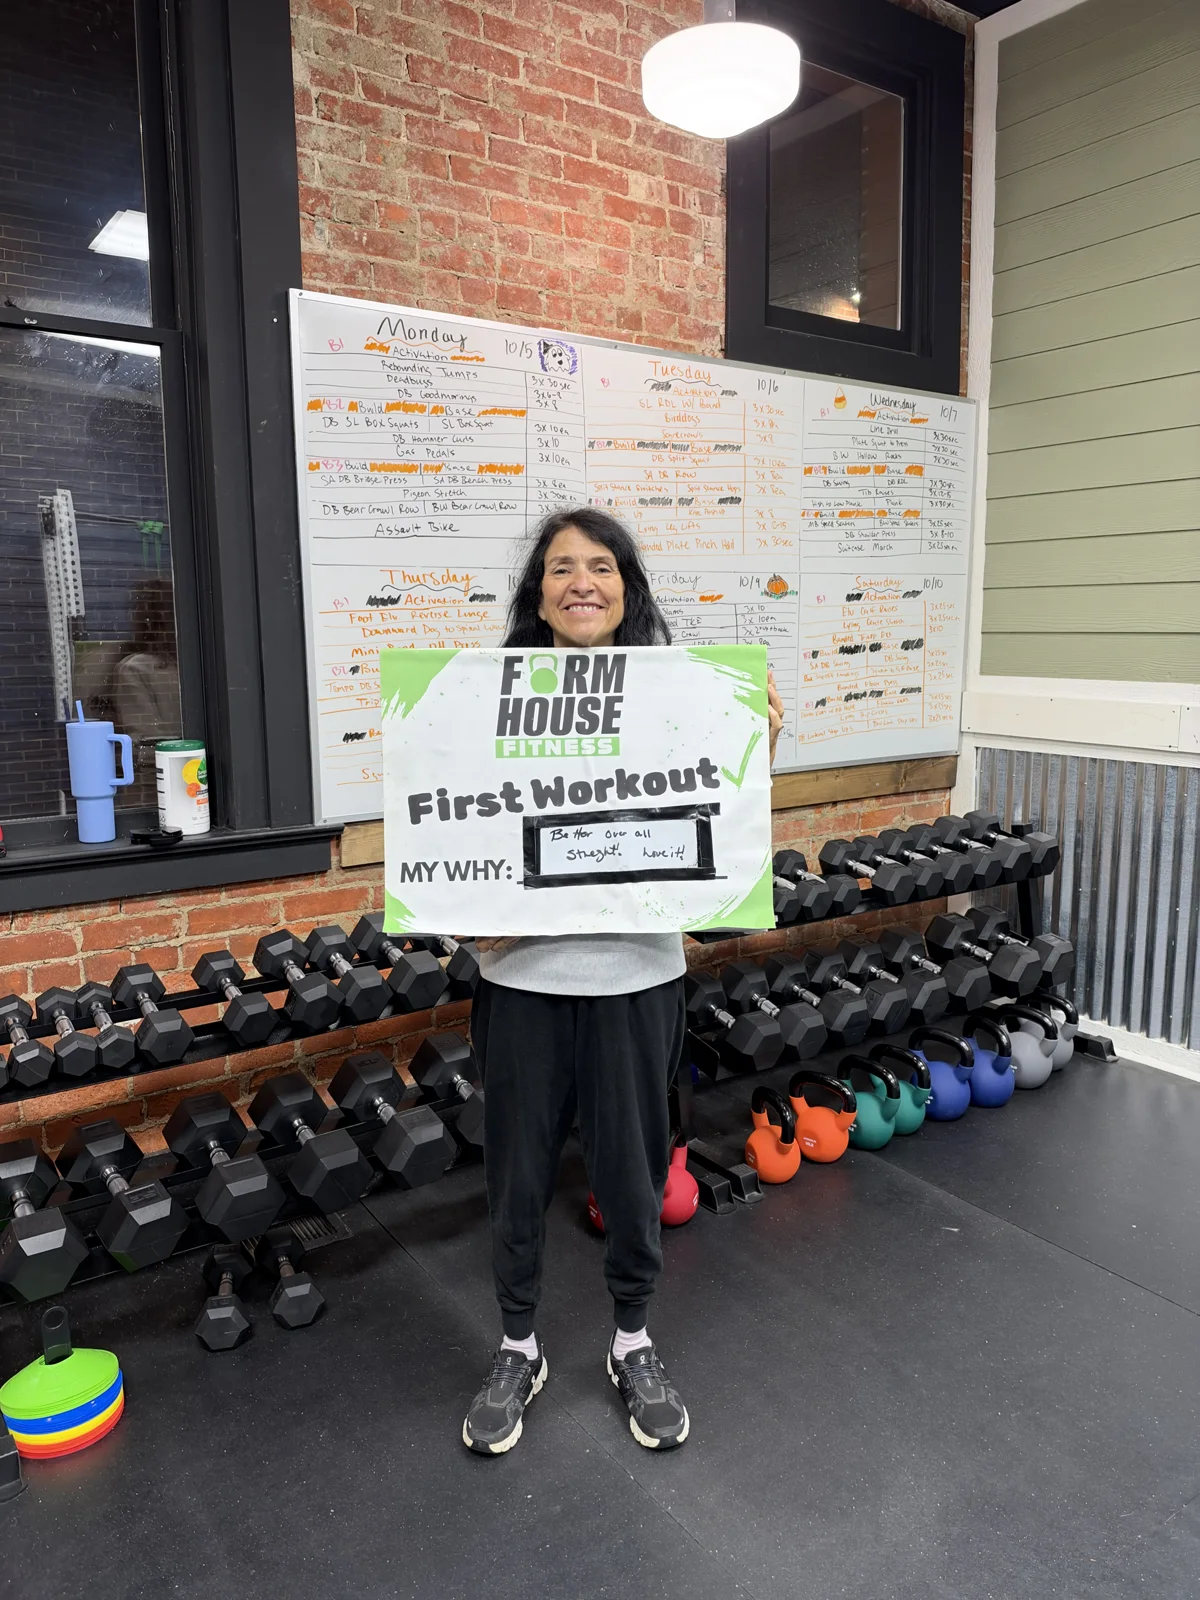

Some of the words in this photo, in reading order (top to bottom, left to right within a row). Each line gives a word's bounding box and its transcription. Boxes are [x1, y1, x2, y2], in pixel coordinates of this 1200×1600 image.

[377, 316, 468, 352] Monday
[328, 338, 344, 352] B1
[504, 338, 533, 359] 10/5
[393, 346, 448, 361] Activation
[381, 360, 432, 376] Rebounding
[436, 367, 478, 380] Jumps
[648, 360, 711, 383] Tuesday
[386, 374, 433, 388] Deadbugs
[600, 377, 610, 388] B1
[757, 378, 779, 395] 10/6
[397, 389, 412, 398] DB
[673, 386, 717, 396] Activation
[326, 398, 344, 410] B2
[358, 400, 385, 414] Build
[639, 399, 652, 409] SL
[657, 397, 676, 409] RDL
[699, 398, 721, 409] Band
[870, 392, 917, 416] Wednesday
[445, 405, 475, 416] Base
[820, 408, 830, 417] B1
[940, 405, 958, 421] 10/7
[322, 416, 338, 428] DB
[346, 416, 359, 427] SL
[387, 418, 419, 431] Squats
[664, 412, 701, 427] Birddogs
[877, 412, 909, 423] Activation
[442, 418, 455, 429] SL
[474, 420, 494, 431] Squat
[870, 424, 884, 434] Line
[886, 427, 899, 435] Drill
[392, 434, 406, 444] DB
[410, 435, 448, 443] Hammer
[452, 434, 474, 443] Curls
[852, 436, 868, 446] Plate
[871, 438, 886, 450] Squat
[396, 445, 415, 458] Gas
[426, 448, 455, 458] Pedals
[613, 439, 636, 450] Build
[690, 442, 712, 454] Base
[651, 454, 664, 462] DB
[667, 454, 686, 464] Split
[689, 456, 710, 466] Squat
[833, 451, 849, 461] BW
[322, 460, 343, 472] B3
[344, 461, 369, 472] Build
[828, 466, 846, 475] Build
[886, 467, 904, 475] Base
[321, 475, 335, 486] SA
[339, 476, 351, 484] DB
[383, 476, 408, 485] Press
[433, 476, 445, 485] SA
[447, 476, 459, 485] DB
[461, 476, 488, 485] Bench
[491, 477, 512, 486] Press
[675, 470, 696, 480] Row
[403, 489, 431, 500] Pigeon
[434, 488, 467, 498] Stretch
[432, 502, 448, 510] BW
[451, 502, 474, 511] Bear
[475, 502, 497, 512] Crawl
[499, 501, 517, 510] Row
[615, 497, 637, 507] Build
[323, 504, 340, 515] DB
[342, 505, 366, 516] Bear
[367, 505, 394, 514] Crawl
[399, 503, 419, 514] Row
[375, 523, 421, 537] Assault
[428, 521, 460, 532] Bike
[666, 539, 689, 551] Plate
[695, 537, 718, 550] Pinch
[873, 543, 893, 551] March
[379, 568, 478, 597] Thursday
[650, 573, 701, 590] Friday
[740, 575, 760, 589] 10/9
[855, 576, 904, 590] Saturday
[924, 577, 943, 590] 10/10
[404, 593, 465, 606] Activation
[816, 594, 826, 603] B1
[863, 591, 901, 601] Activation
[333, 597, 349, 610] B1
[349, 612, 373, 624] Foot
[411, 611, 452, 620] Reverse
[457, 609, 489, 622] Lunge
[362, 627, 417, 638] Downward
[424, 624, 440, 637] Dog
[351, 647, 379, 658] Mini
[332, 667, 348, 676] B2
[325, 682, 354, 693] Tempo
[360, 682, 371, 691] DB
[496, 695, 623, 737] HOUSE
[502, 738, 613, 757] FITNESS
[408, 781, 524, 825] First
[530, 757, 720, 809] Workout
[400, 861, 439, 883] MY
[443, 859, 512, 882] WHY:
